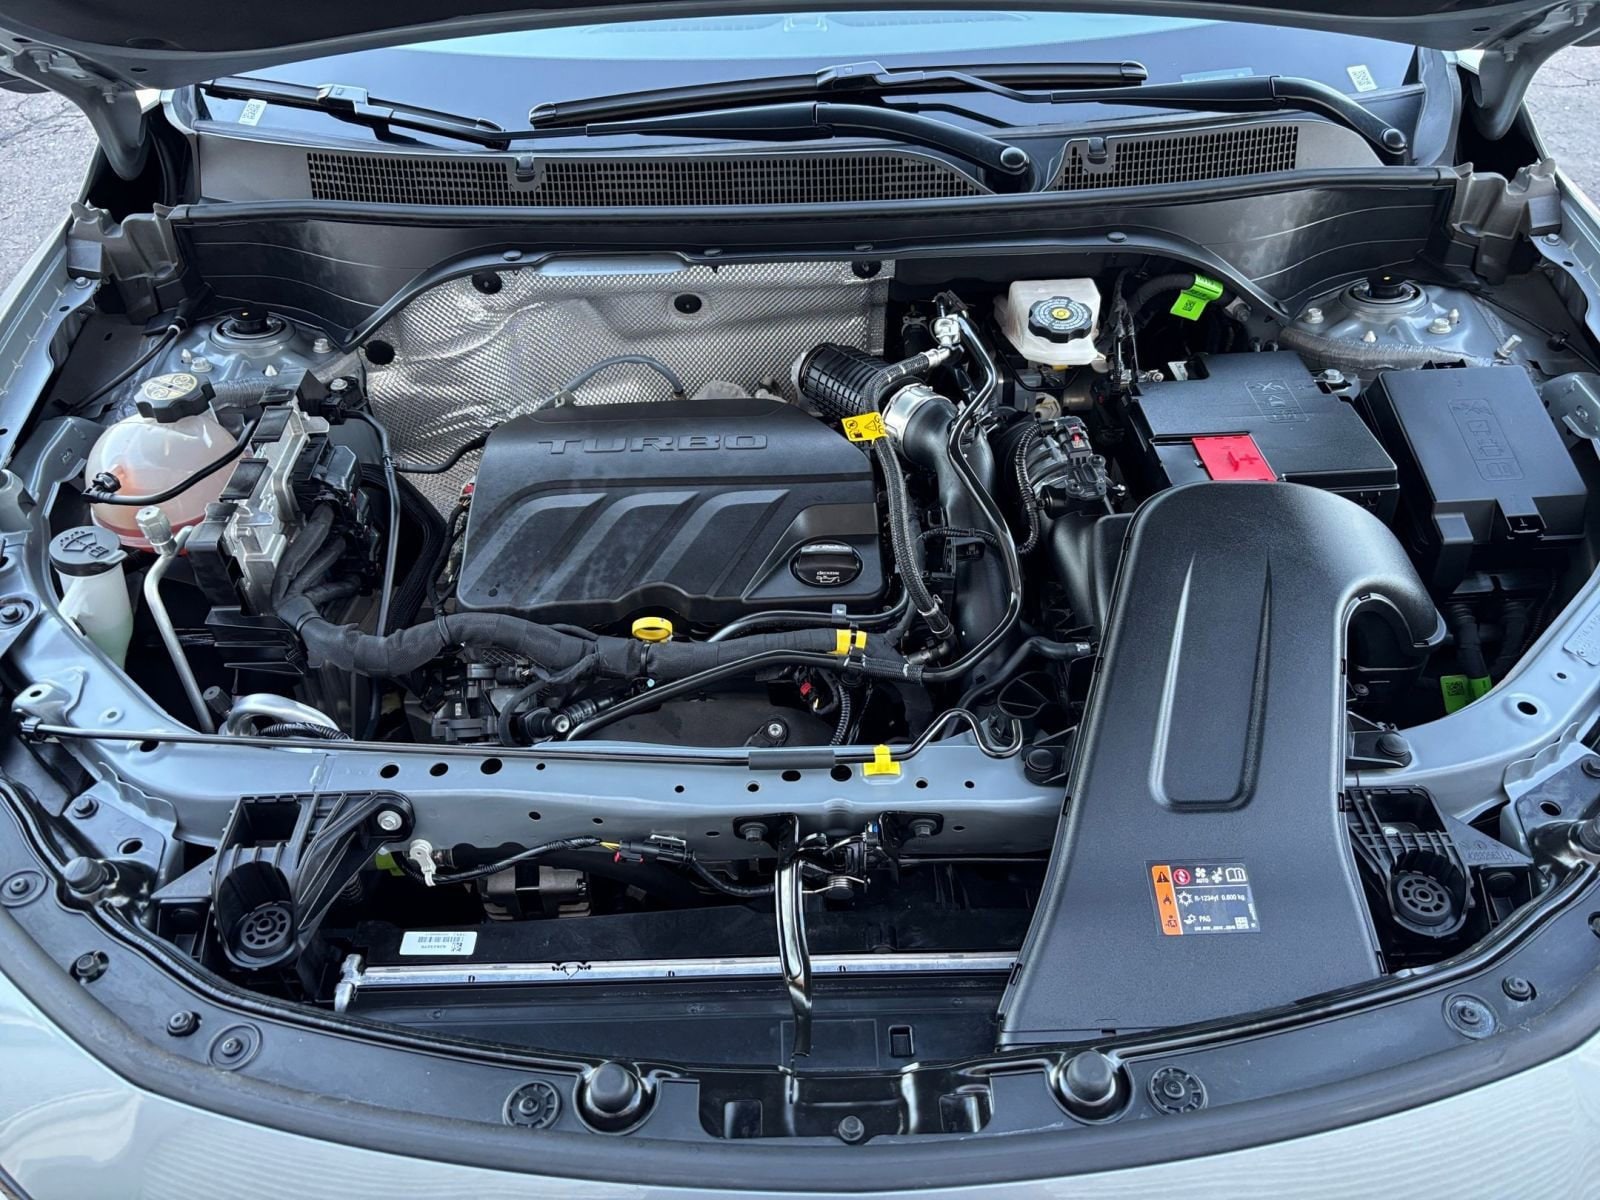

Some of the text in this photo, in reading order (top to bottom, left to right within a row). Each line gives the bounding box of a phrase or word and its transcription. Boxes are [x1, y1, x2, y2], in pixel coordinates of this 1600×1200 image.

[538, 435, 768, 454] TURBO
[1237, 893, 1245, 901] kg
[1198, 915, 1212, 923] PAG
